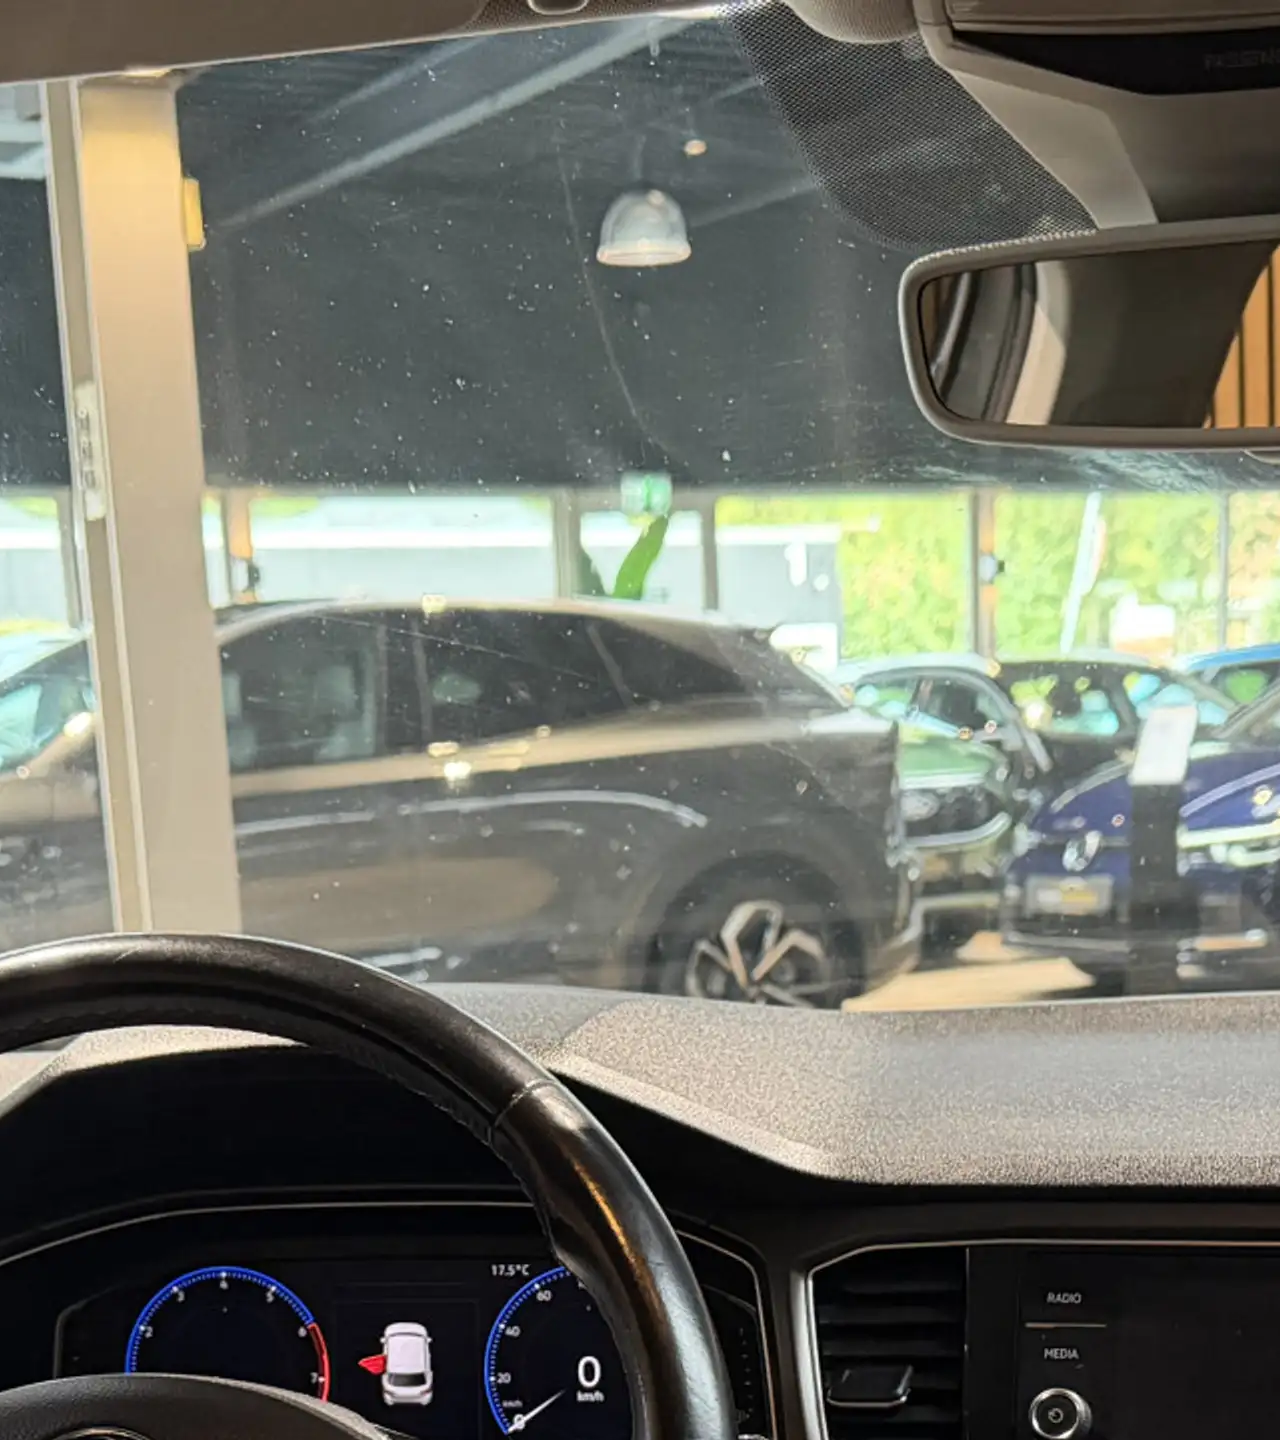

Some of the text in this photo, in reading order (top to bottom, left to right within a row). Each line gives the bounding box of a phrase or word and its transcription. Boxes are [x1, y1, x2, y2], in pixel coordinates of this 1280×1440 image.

[1046, 1292, 1082, 1304] RADIO
[1043, 1348, 1079, 1360] MEDIA
[577, 1356, 601, 1388] 0
[577, 1391, 604, 1402] km/h
